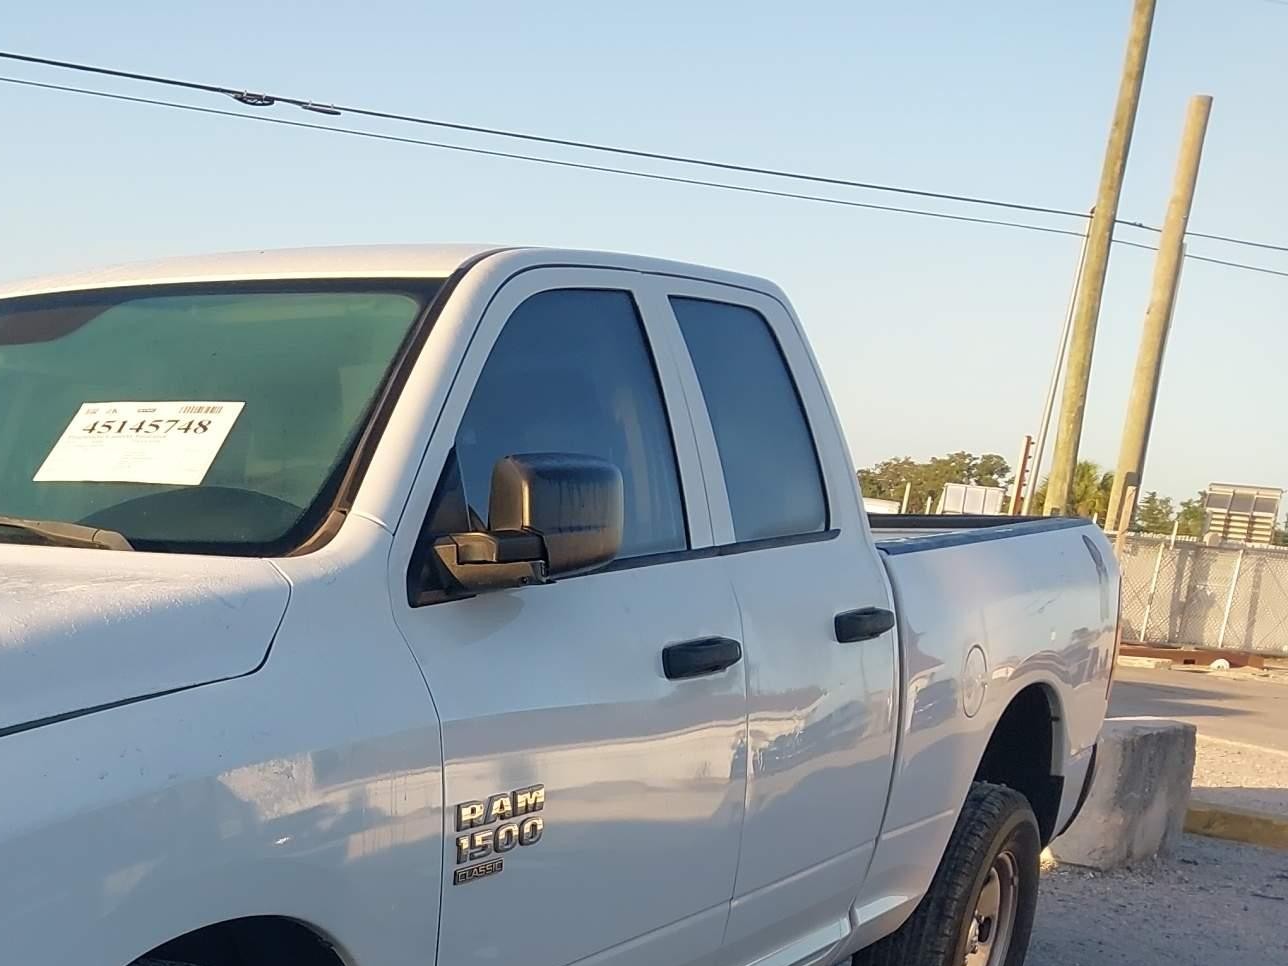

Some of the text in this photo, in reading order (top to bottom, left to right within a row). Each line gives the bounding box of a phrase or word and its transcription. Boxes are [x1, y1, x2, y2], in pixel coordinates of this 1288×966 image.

[82, 419, 212, 434] 45145748
[456, 784, 545, 832] RAM
[456, 816, 545, 864] 1500
[457, 861, 503, 882] CLASSIC
